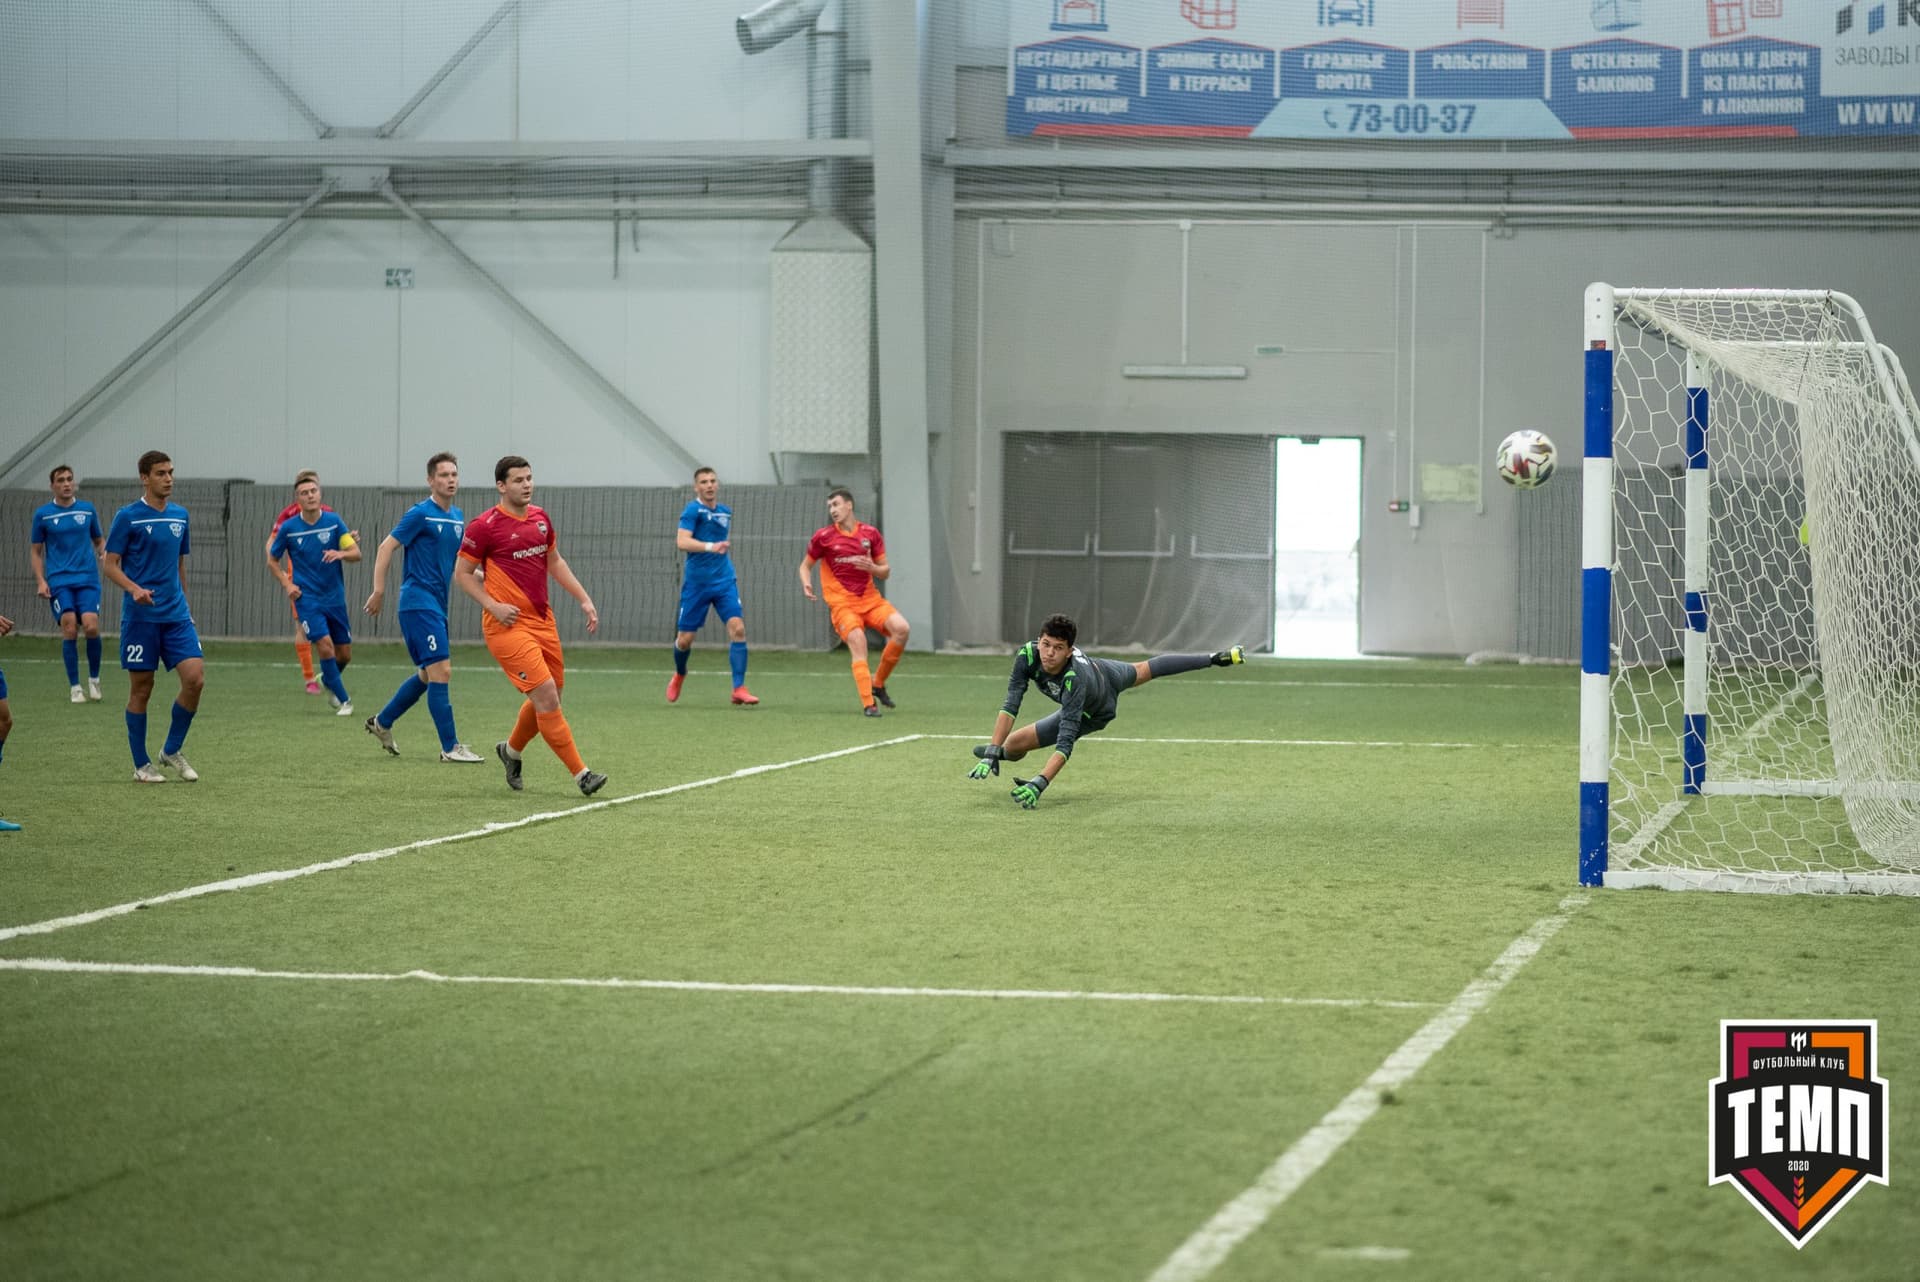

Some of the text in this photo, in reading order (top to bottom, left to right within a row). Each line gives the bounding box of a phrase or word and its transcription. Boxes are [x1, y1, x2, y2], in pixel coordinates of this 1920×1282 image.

[1220, 53, 1265, 71] САДЫ
[1303, 53, 1386, 70] ГАРАЖНЫЕ
[1835, 46, 1909, 67] ЗАВОДЫ
[1184, 75, 1252, 92] ТЕРРАСЫ
[1316, 74, 1373, 91] ВОРОТА
[1346, 103, 1477, 134] 73-00-37
[427, 634, 437, 652] 3
[126, 644, 144, 663] 22
